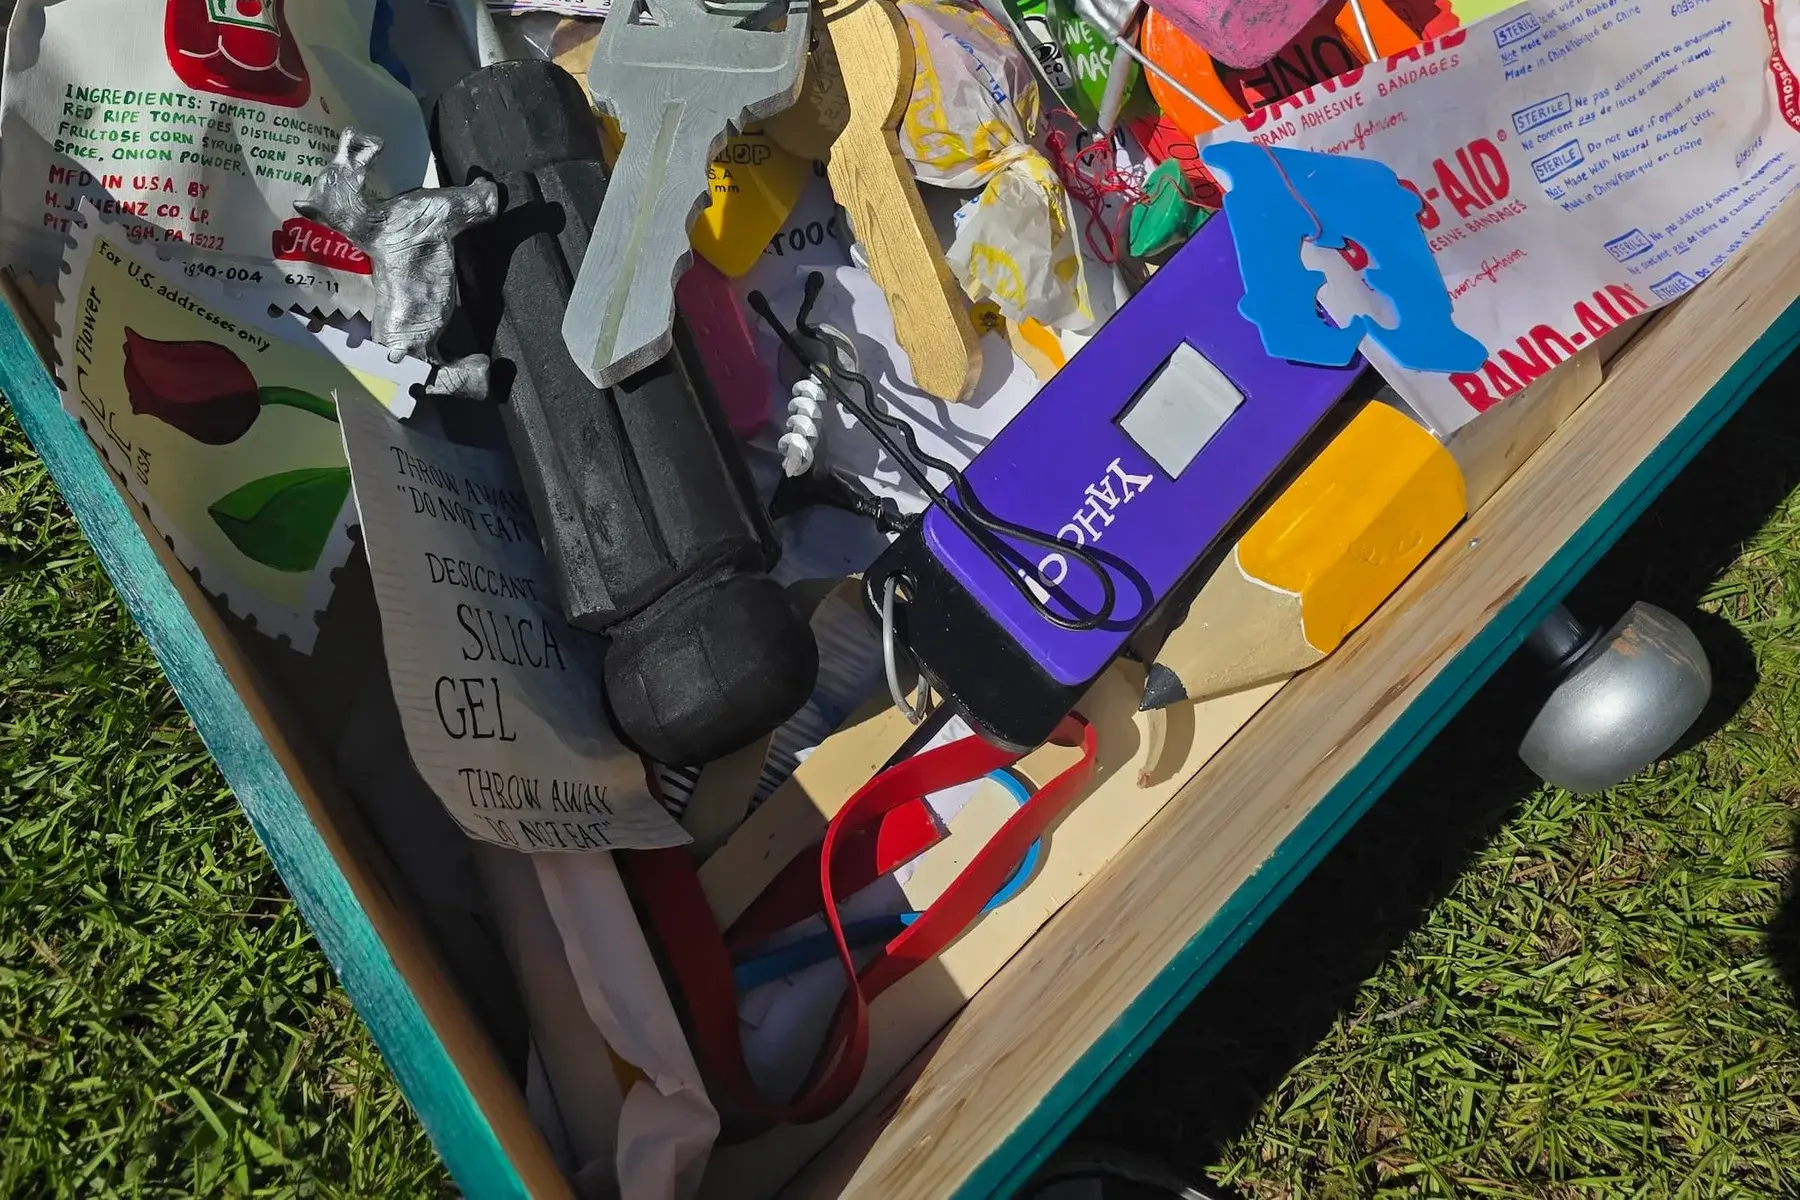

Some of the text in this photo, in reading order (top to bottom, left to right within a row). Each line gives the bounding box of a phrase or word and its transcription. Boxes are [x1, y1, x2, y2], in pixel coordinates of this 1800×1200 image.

[1497, 15, 1538, 44] STERILE
[1505, 61, 1533, 82] Made
[65, 84, 202, 109] INGREDIENTS:
[210, 101, 266, 122] TOMATO
[1301, 55, 1459, 130] ADHESIVE BANDAGES
[1514, 86, 1611, 130] STERILE Ne pas
[58, 121, 141, 143] FRUCTOSE
[150, 131, 194, 144] CORN
[250, 146, 286, 161] CORN
[63, 102, 94, 120] RED
[104, 110, 140, 123] RIPE
[241, 125, 300, 144] DISTILLED
[308, 139, 338, 153] VINE
[1520, 102, 1612, 152] Ne pas de
[1534, 147, 1578, 178] STERILE
[1586, 138, 1602, 153] Do
[1604, 131, 1622, 145] not
[1625, 121, 1646, 138] use
[1656, 132, 1704, 162] en Chine
[49, 164, 210, 199] MFD IN U.S.A. BY
[112, 148, 317, 186] ONION POWDER, NATURA
[1544, 182, 1565, 200] Not
[1563, 170, 1588, 189] Made
[1587, 157, 1610, 175] With
[1611, 136, 1650, 163] Natural
[1469, 198, 1528, 233] BANDAGES
[164, 229, 224, 250] PA 15222
[282, 225, 365, 262] Heinz
[1609, 230, 1646, 261] STERILE
[98, 240, 271, 353] For U.S. addresses only
[285, 274, 339, 292] 627-11
[76, 285, 100, 365] Flower
[137, 448, 152, 486] USA
[390, 446, 460, 496] THROW
[438, 496, 477, 531] NOT
[425, 552, 537, 602] DESICCANT
[456, 603, 567, 671] SILICA
[434, 675, 517, 743] GEL
[459, 768, 614, 815] THROW AWAY
[519, 820, 567, 848] NOT
